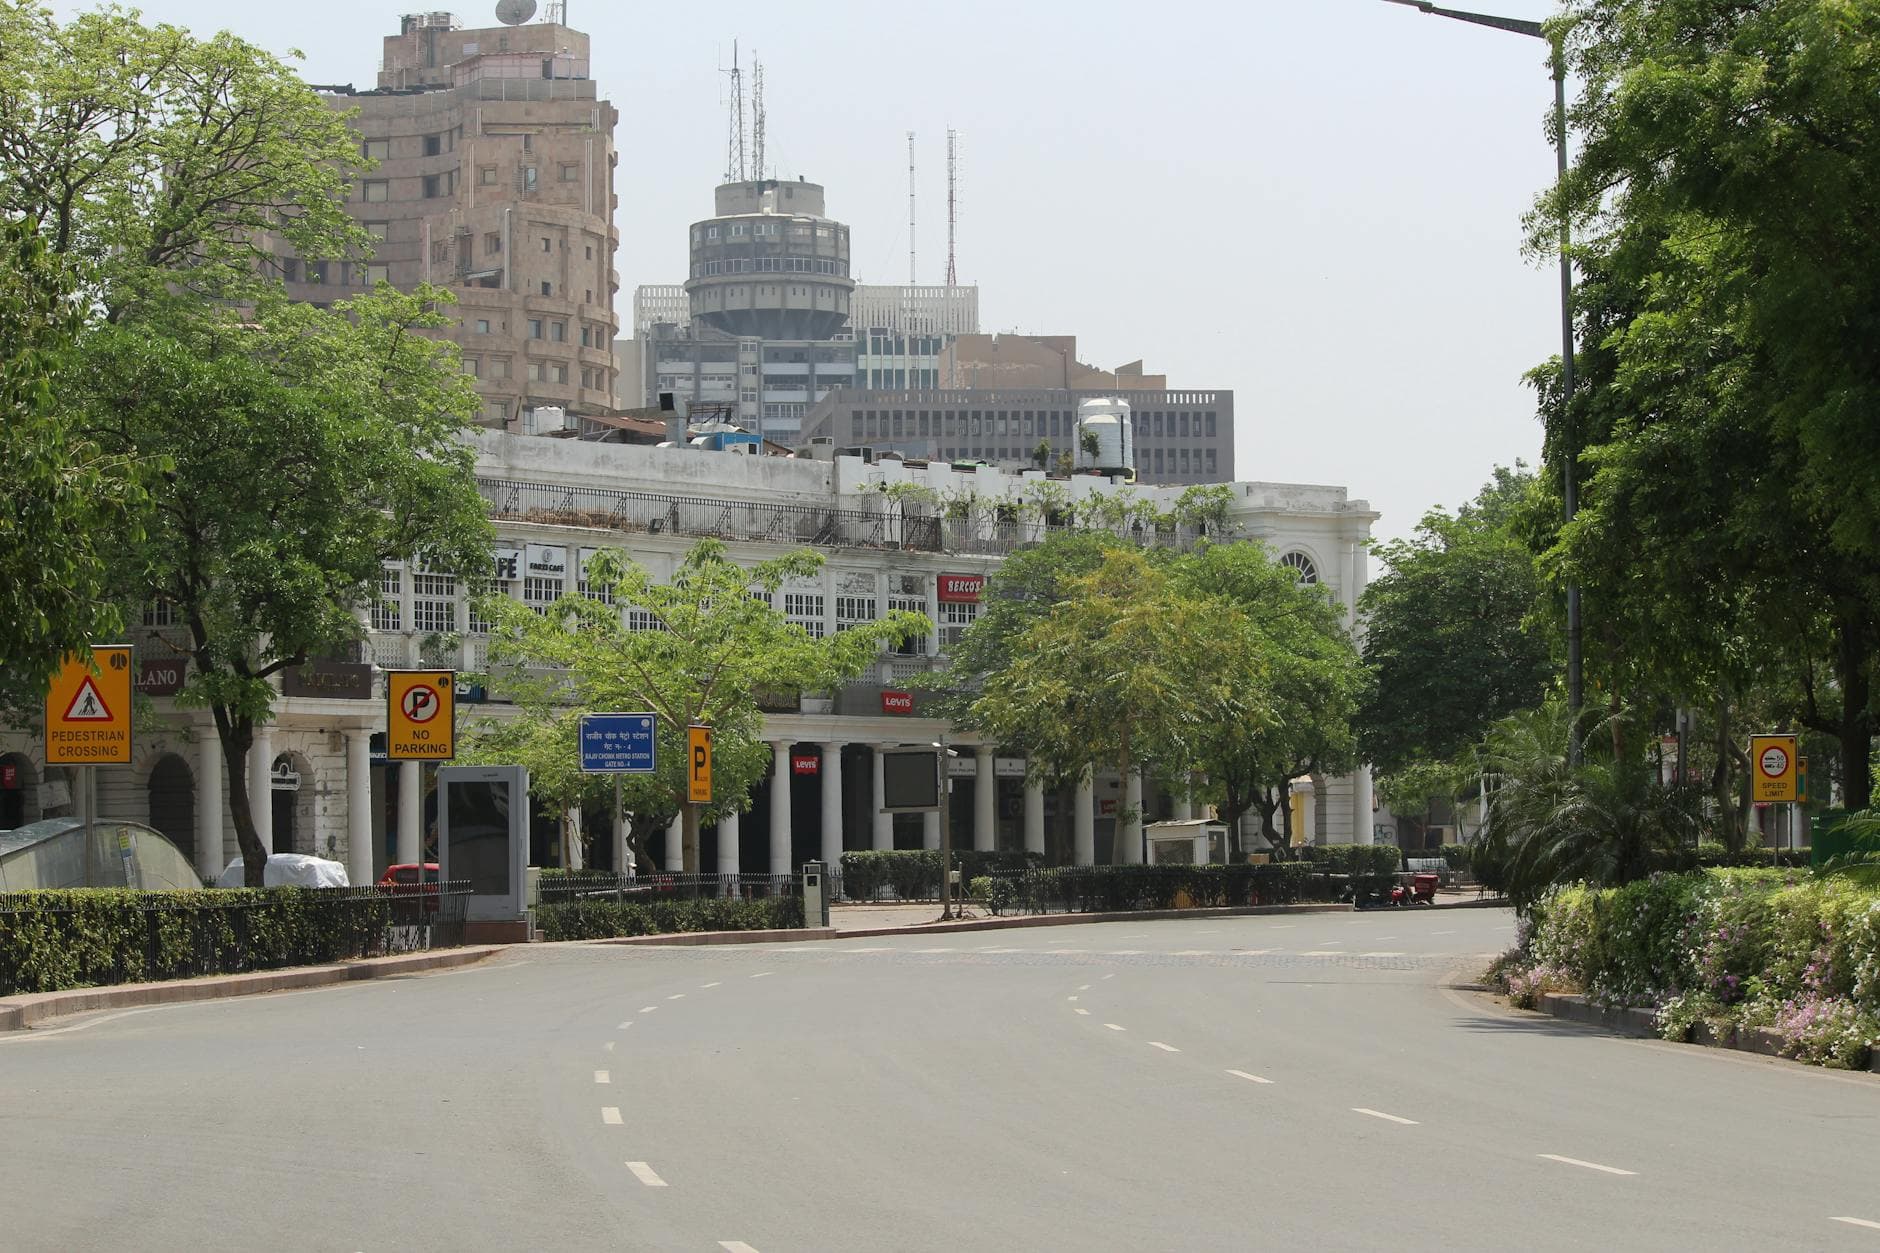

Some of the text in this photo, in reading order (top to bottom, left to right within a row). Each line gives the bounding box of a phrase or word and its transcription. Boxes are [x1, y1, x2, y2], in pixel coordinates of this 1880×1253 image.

[52, 730, 125, 742] PEDESTRIAN
[412, 730, 430, 740] NO
[58, 745, 119, 757] CROSSING
[394, 743, 448, 754] PARKING
[694, 745, 706, 781] P
